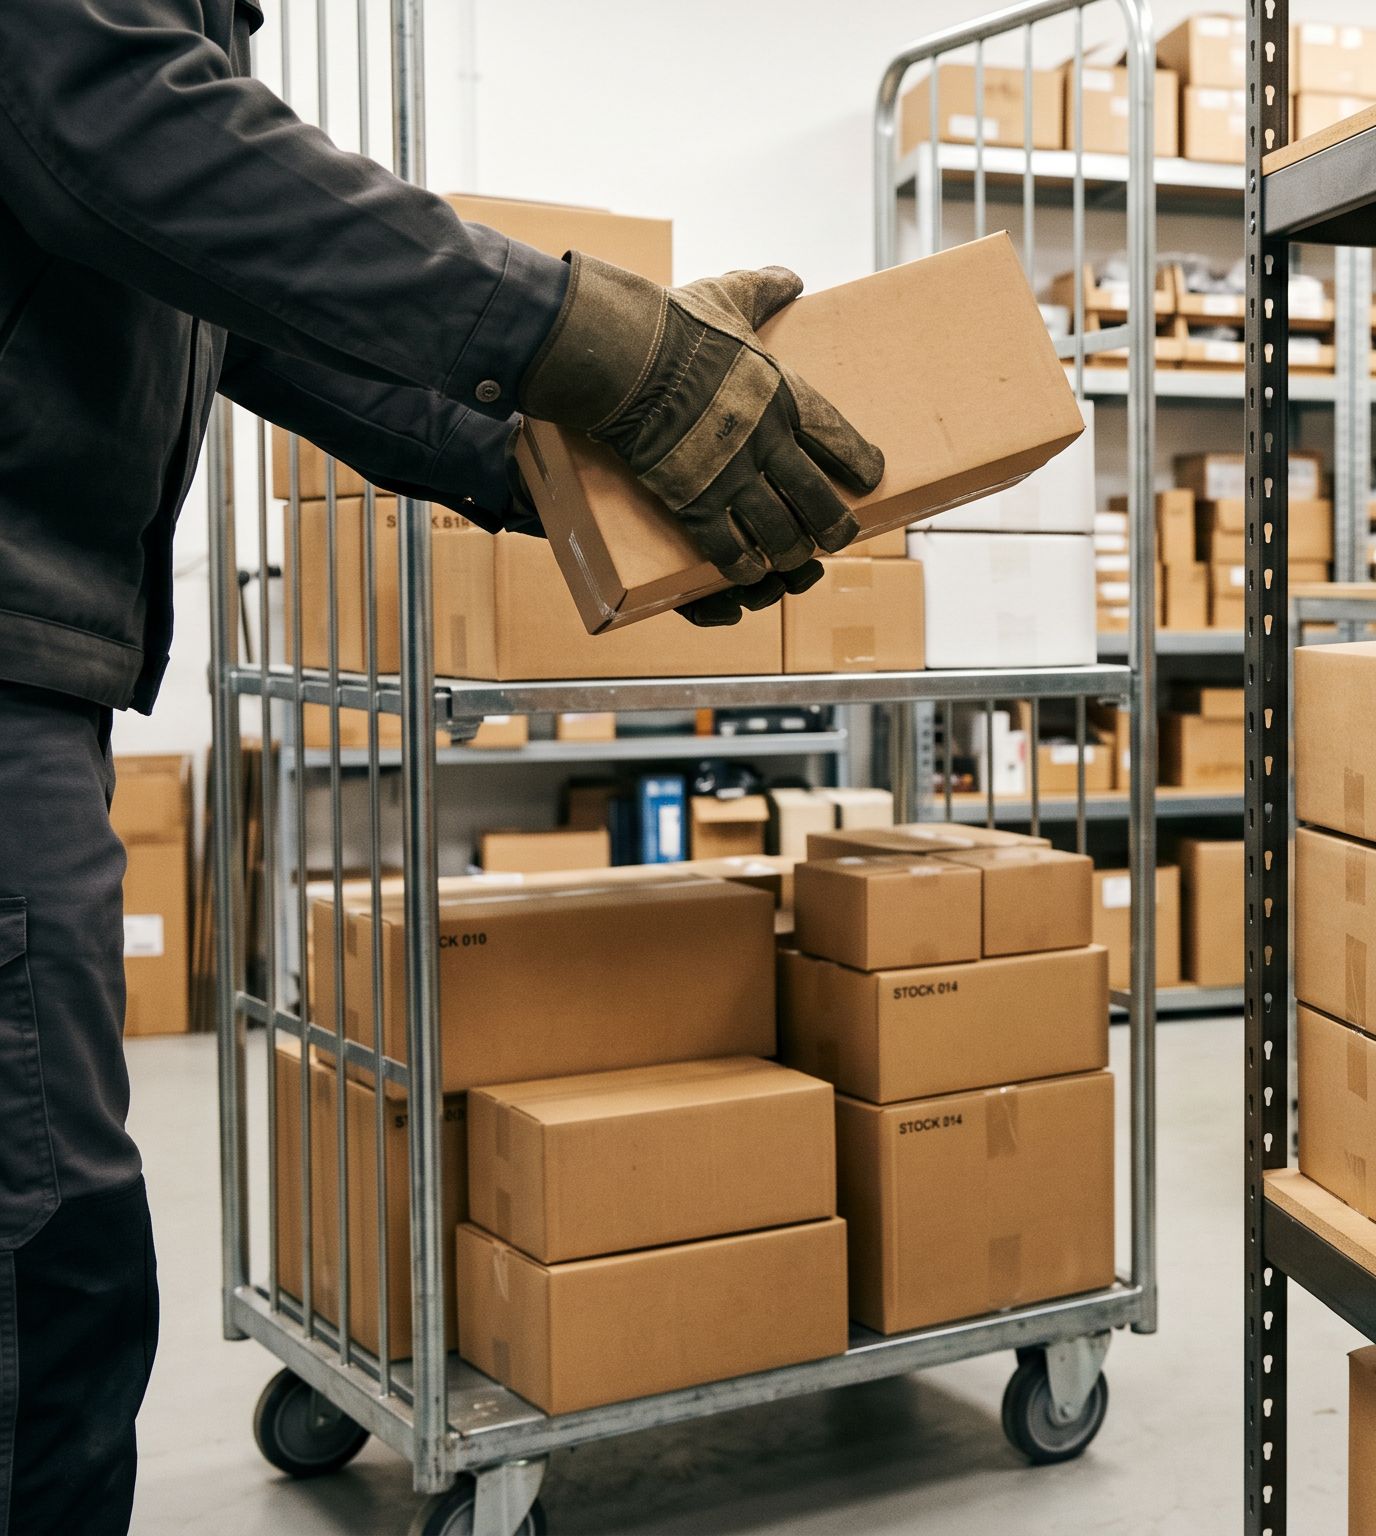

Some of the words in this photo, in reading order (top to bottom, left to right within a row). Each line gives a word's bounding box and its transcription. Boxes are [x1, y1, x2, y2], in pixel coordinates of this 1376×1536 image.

[462, 932, 487, 947] 010
[893, 983, 936, 1000] STOCK
[899, 1116, 941, 1135] STOCK
